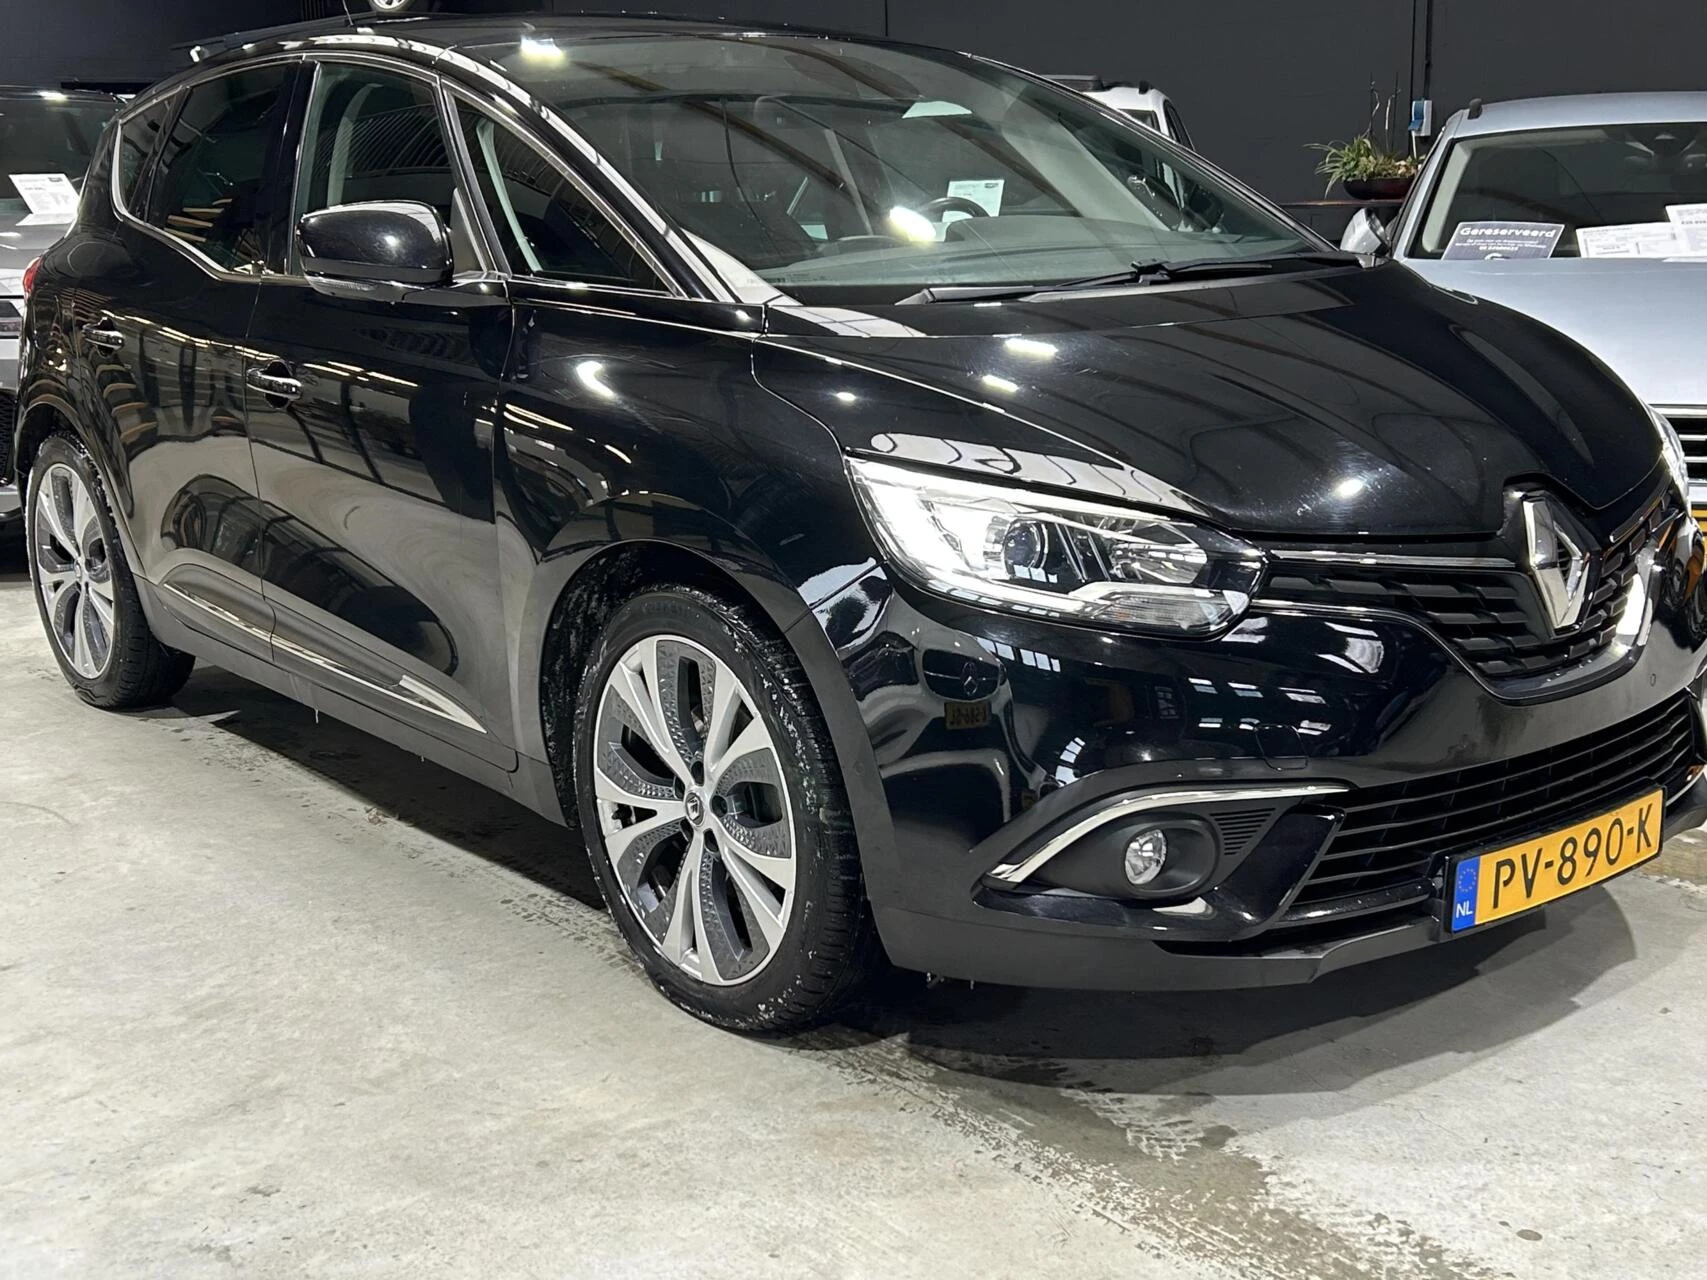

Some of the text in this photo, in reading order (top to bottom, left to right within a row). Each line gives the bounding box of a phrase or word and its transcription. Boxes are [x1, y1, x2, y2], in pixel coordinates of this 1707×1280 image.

[1460, 226, 1557, 239] Gereserveerd
[1492, 803, 1653, 908] PV-890-K
[1455, 901, 1473, 918] NL
